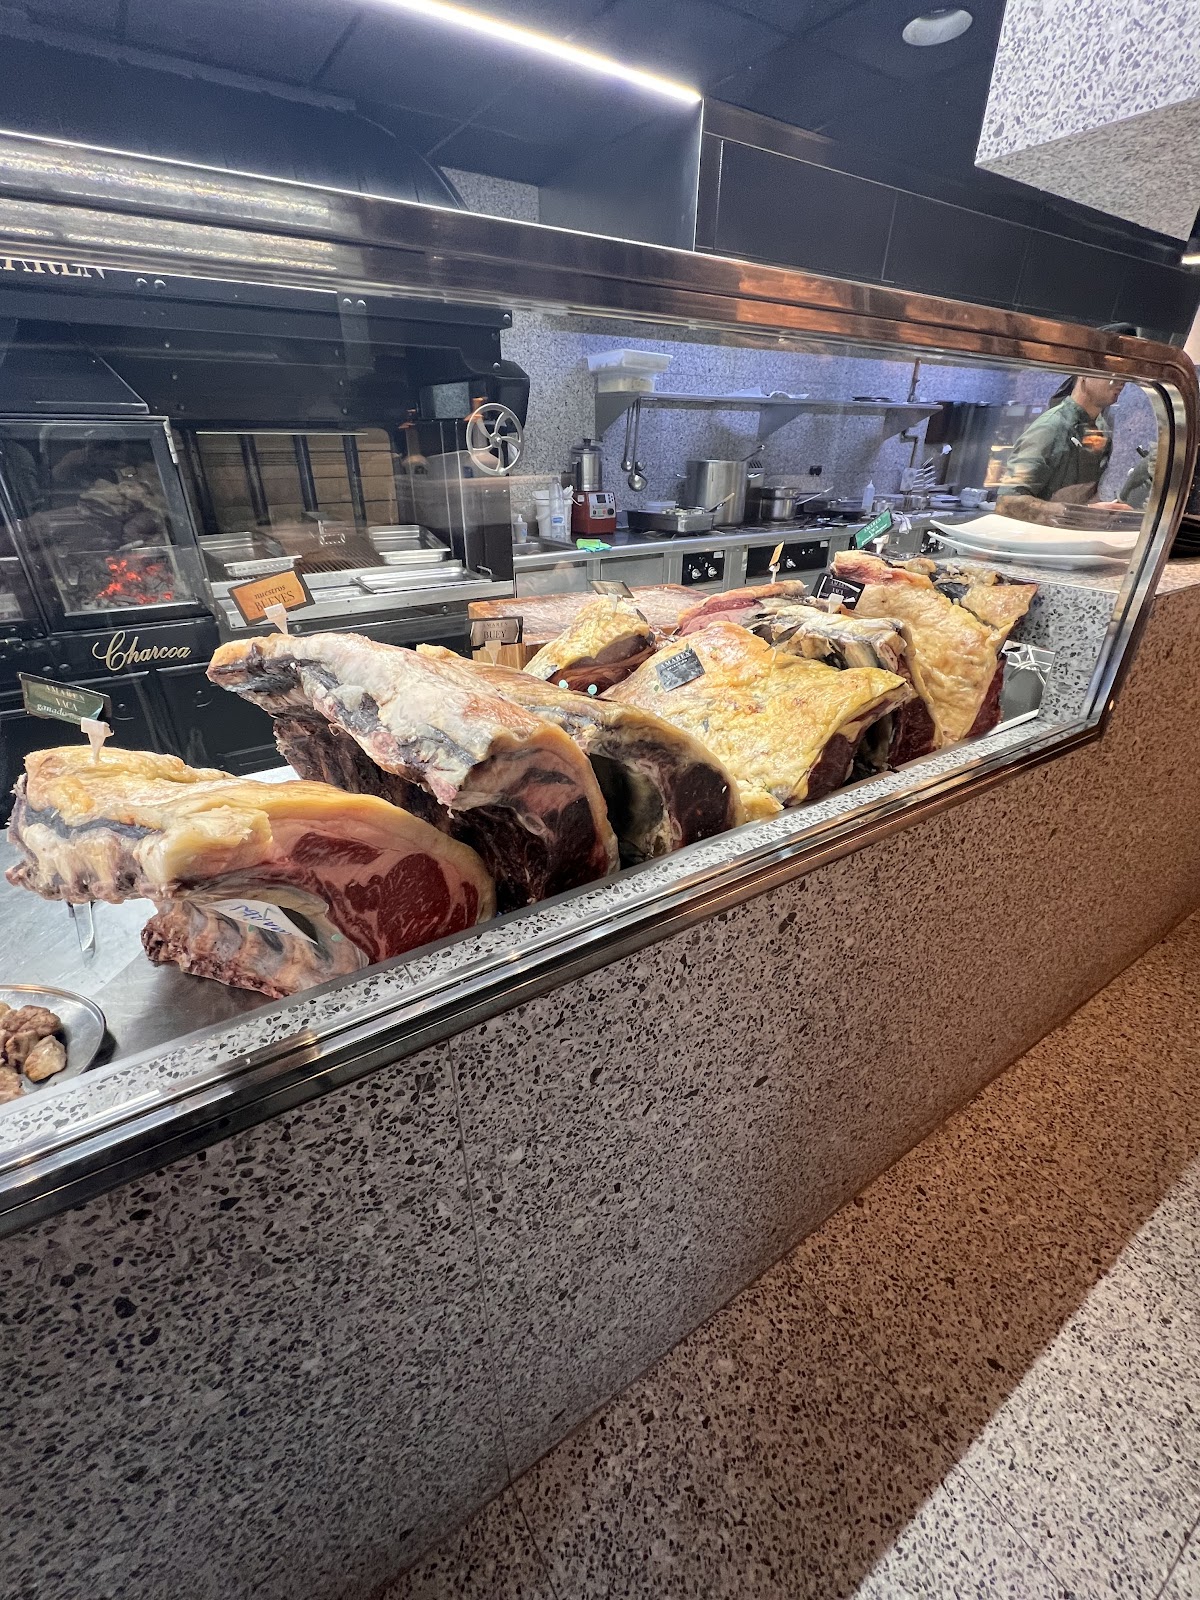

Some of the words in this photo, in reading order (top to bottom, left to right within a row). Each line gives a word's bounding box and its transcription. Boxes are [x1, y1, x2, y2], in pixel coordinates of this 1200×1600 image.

[254, 584, 286, 600] nuestros
[254, 590, 295, 612] BUEYES
[483, 629, 507, 640] BUEY
[92, 631, 191, 670] Charcoa
[36, 703, 67, 717] ganado
